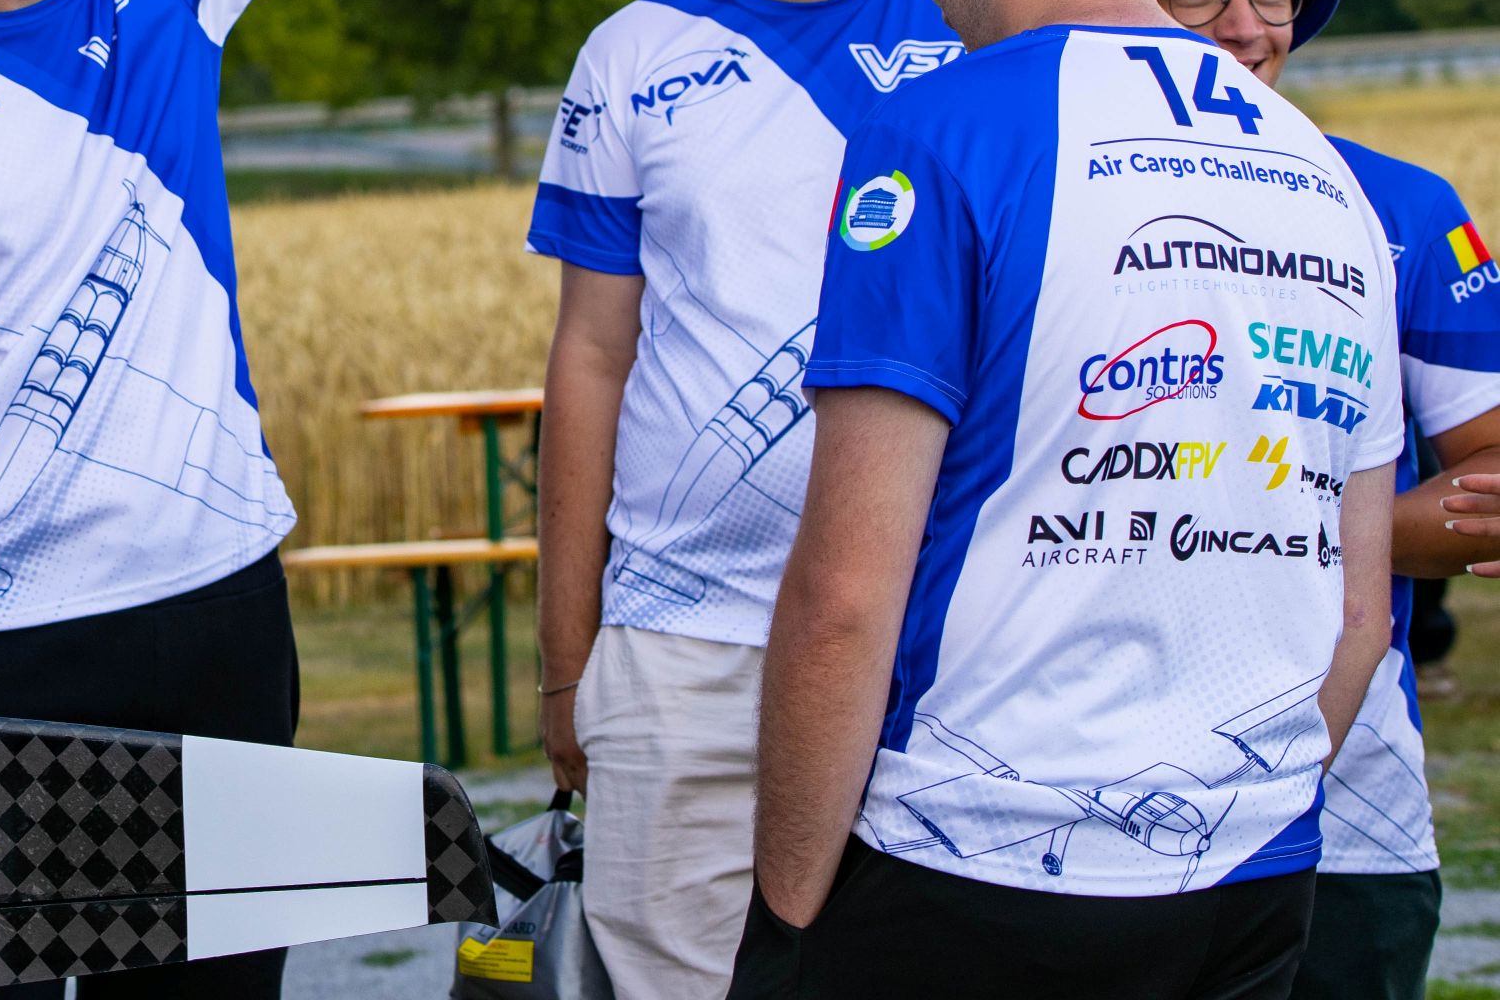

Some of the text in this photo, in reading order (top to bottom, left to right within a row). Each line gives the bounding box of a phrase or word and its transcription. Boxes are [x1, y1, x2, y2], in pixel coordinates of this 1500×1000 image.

[631, 59, 751, 118] NOVA
[1123, 46, 1263, 135] 14
[1088, 152, 1349, 209] Air Cargo Challenge 2026
[1113, 240, 1366, 299] AUTONOMOUS
[1450, 261, 1500, 304] ROU
[1079, 347, 1225, 394] Contras
[1248, 321, 1373, 390] SEMEN
[1144, 384, 1218, 401] SOLUTIONS
[1027, 510, 1105, 545] AVI
[1021, 547, 1148, 568] AIRCRAFT
